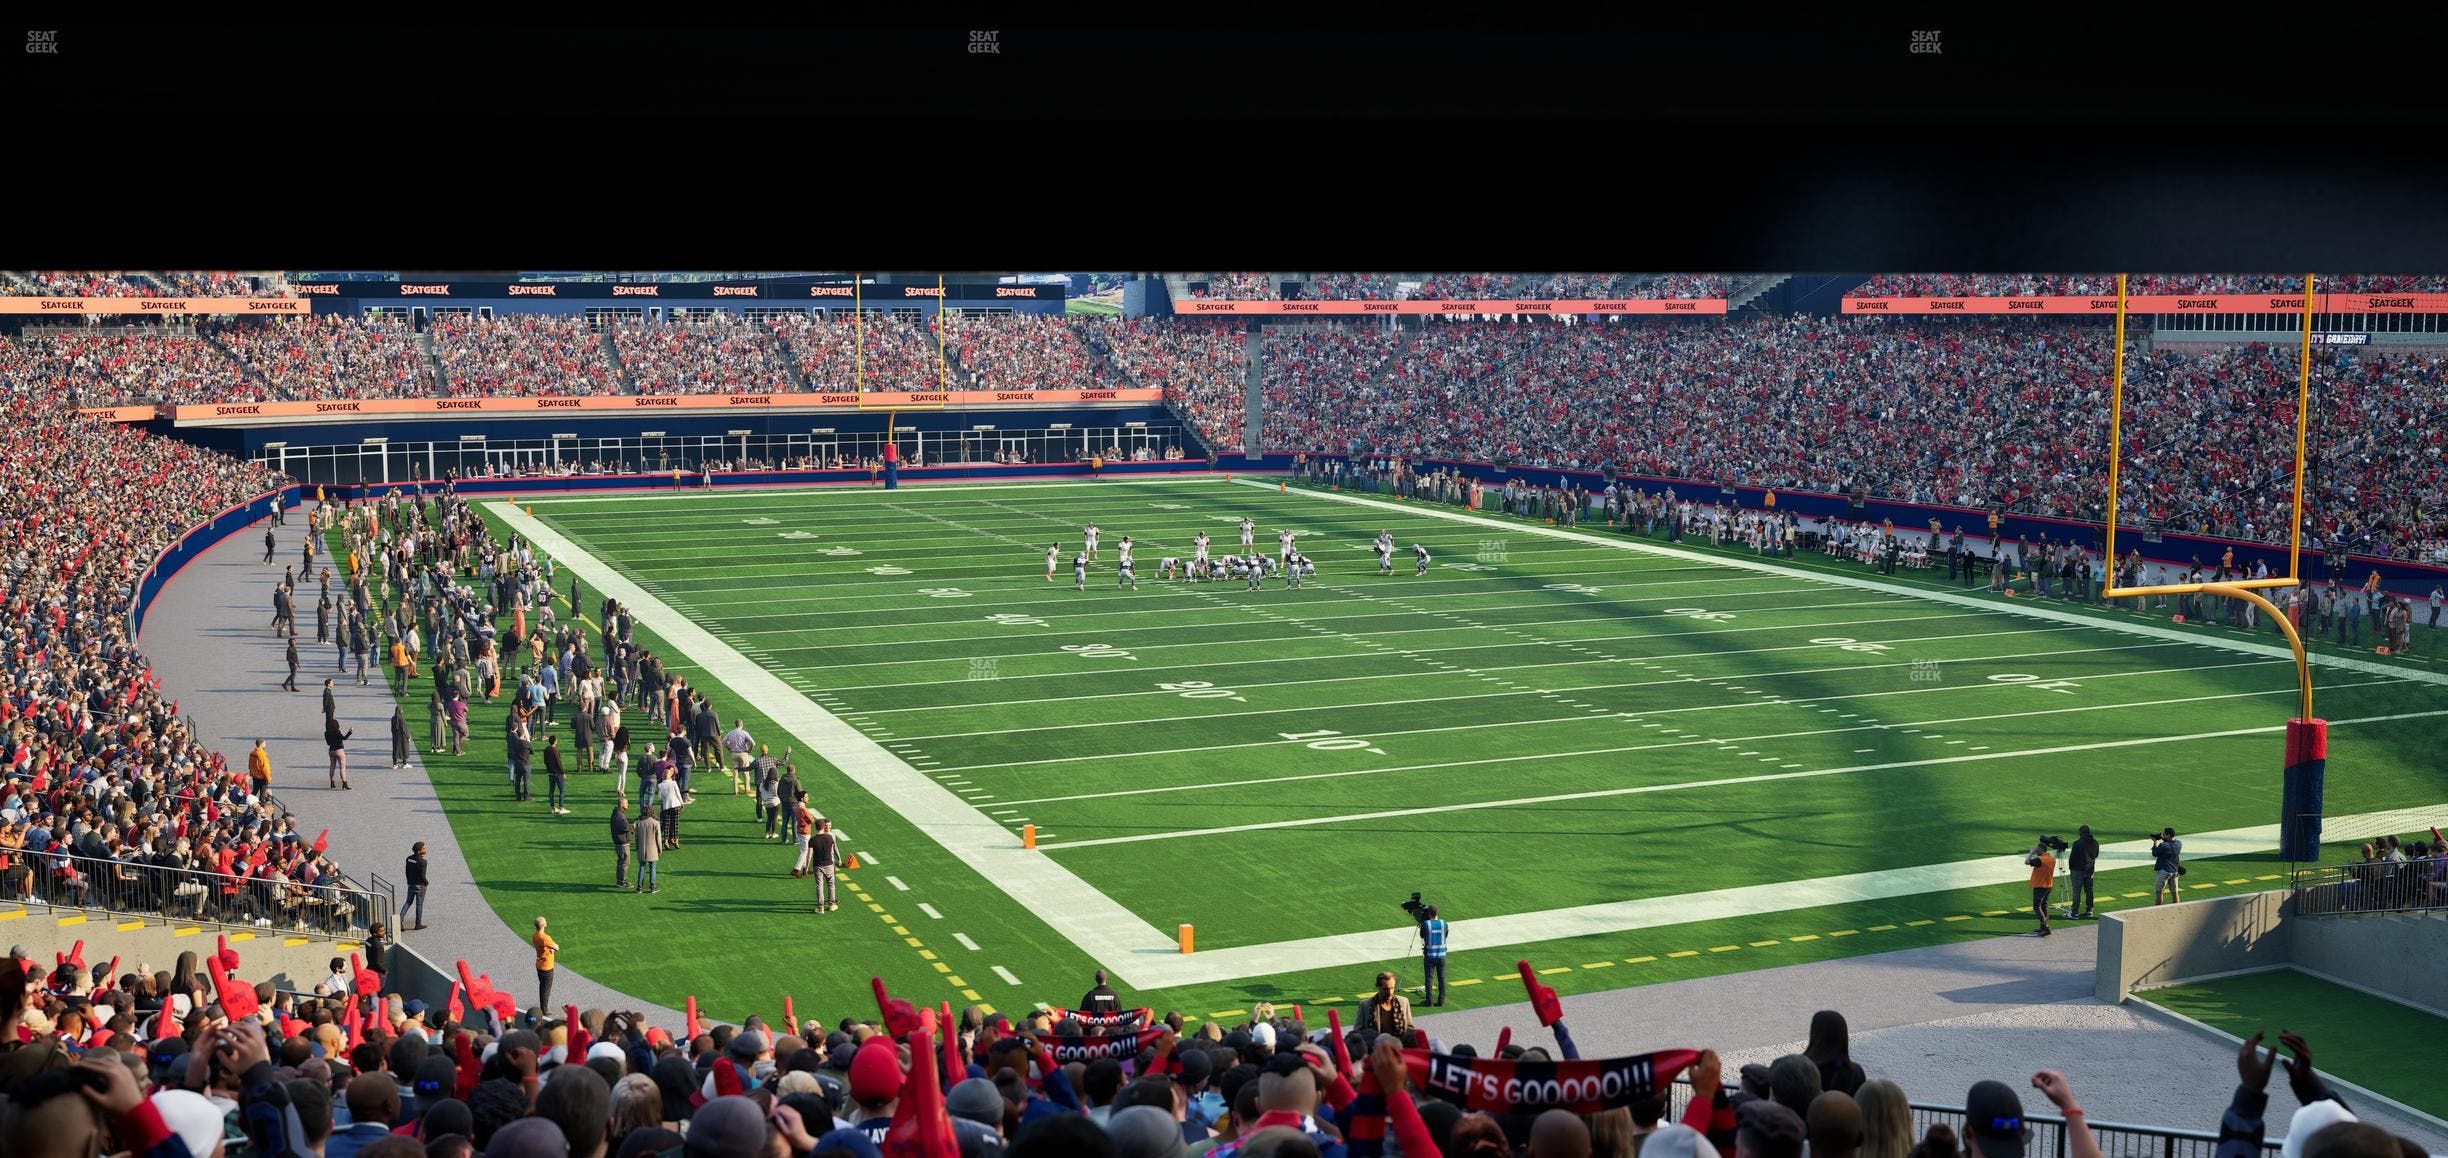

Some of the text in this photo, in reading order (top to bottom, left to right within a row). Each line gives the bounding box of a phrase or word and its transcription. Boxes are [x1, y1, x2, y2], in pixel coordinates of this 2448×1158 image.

[294, 284, 340, 295] EATGEEK
[400, 285, 449, 295] SEATGEEK
[508, 285, 556, 295] SEATGEEK
[612, 286, 658, 296] SEATGEEK
[713, 286, 757, 296] SEATGEEK
[811, 286, 853, 296] SEATGEEK
[995, 288, 1036, 297] SEATGEEK
[40, 300, 296, 310] SEATGEEK SEATGEEK SEATGEEK
[1196, 302, 1695, 311] SEATGEEK SEATGEEK SEATGEEK SEATGEEK SEATGEEK SEATGEEK SEATGEEK
[1856, 301, 1888, 310] SEATGEEK
[1930, 301, 1964, 310] SEATGEEK
[2008, 300, 2043, 309] SEATGEEK
[2177, 300, 2217, 309] SEATGEEK
[2368, 298, 2415, 308] SEATGEEK
[216, 406, 260, 415] SEATGEEK
[316, 403, 360, 412] SEATGEEK
[436, 400, 481, 409] SEATGEEK
[537, 399, 581, 408] SEATGEEK
[635, 397, 677, 406] SEATGEEK
[729, 396, 770, 405] SEATGEEK
[996, 392, 1033, 401] SEATGEEK
[1080, 391, 1116, 400] SEATGEEK
[1060, 643, 1130, 658] 30
[1154, 681, 1236, 698] 20
[1278, 729, 1371, 750] 10
[1429, 1058, 1651, 1104] LET'S GOOOOO!!!
